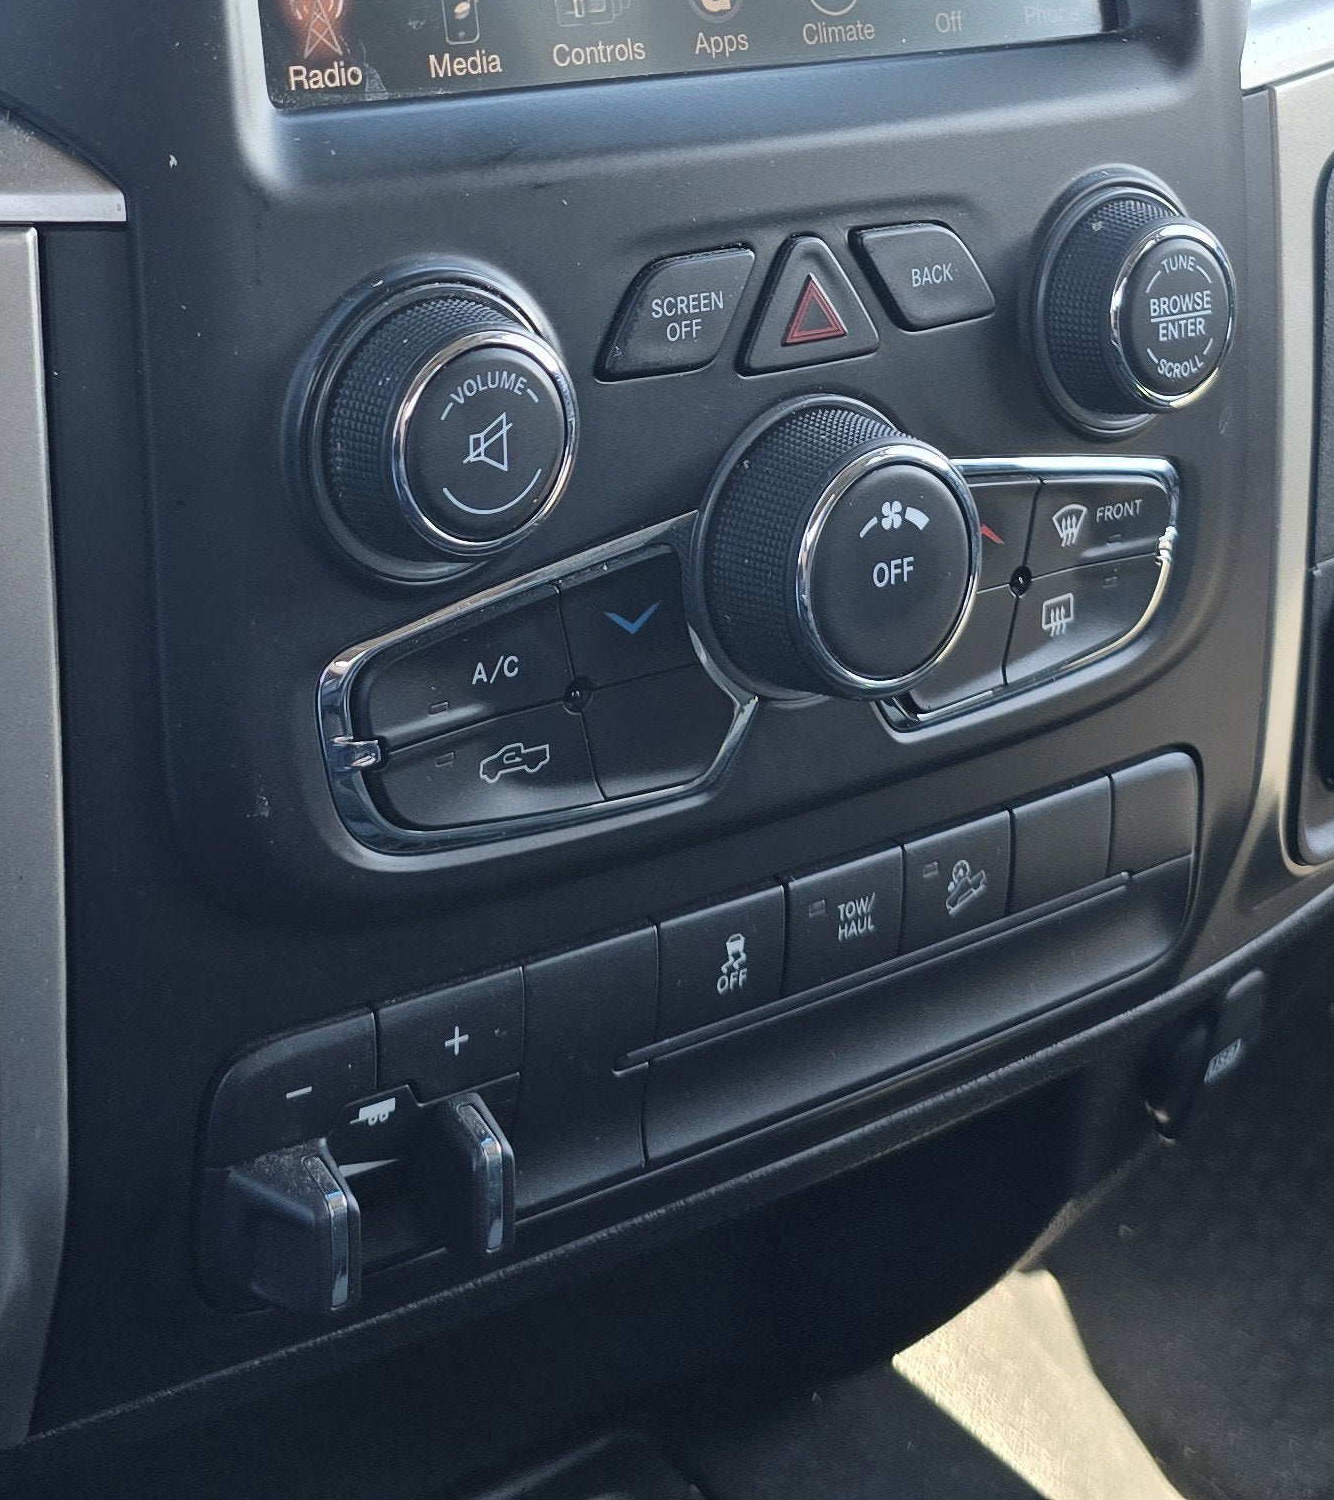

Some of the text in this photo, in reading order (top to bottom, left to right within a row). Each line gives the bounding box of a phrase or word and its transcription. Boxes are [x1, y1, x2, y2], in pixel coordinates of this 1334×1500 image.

[802, 19, 876, 46] Climate
[934, 11, 964, 34] Off
[552, 38, 646, 68] Controls
[695, 30, 750, 59] Apps
[288, 61, 364, 92] Radio
[428, 50, 503, 79] Media
[910, 262, 955, 288] BACK
[1160, 255, 1197, 274] TUNE
[650, 290, 725, 320] SCREEN
[1149, 290, 1213, 317] BROWSE
[665, 319, 703, 342] OFF
[1157, 317, 1206, 342] ENTER
[1156, 355, 1205, 379] SCROLL
[449, 369, 528, 406] VOLUME
[1095, 498, 1144, 524] FRONT
[872, 555, 916, 590] OFF
[471, 654, 521, 686] A/C
[837, 915, 875, 942] HAUL
[716, 968, 748, 995] OFF
